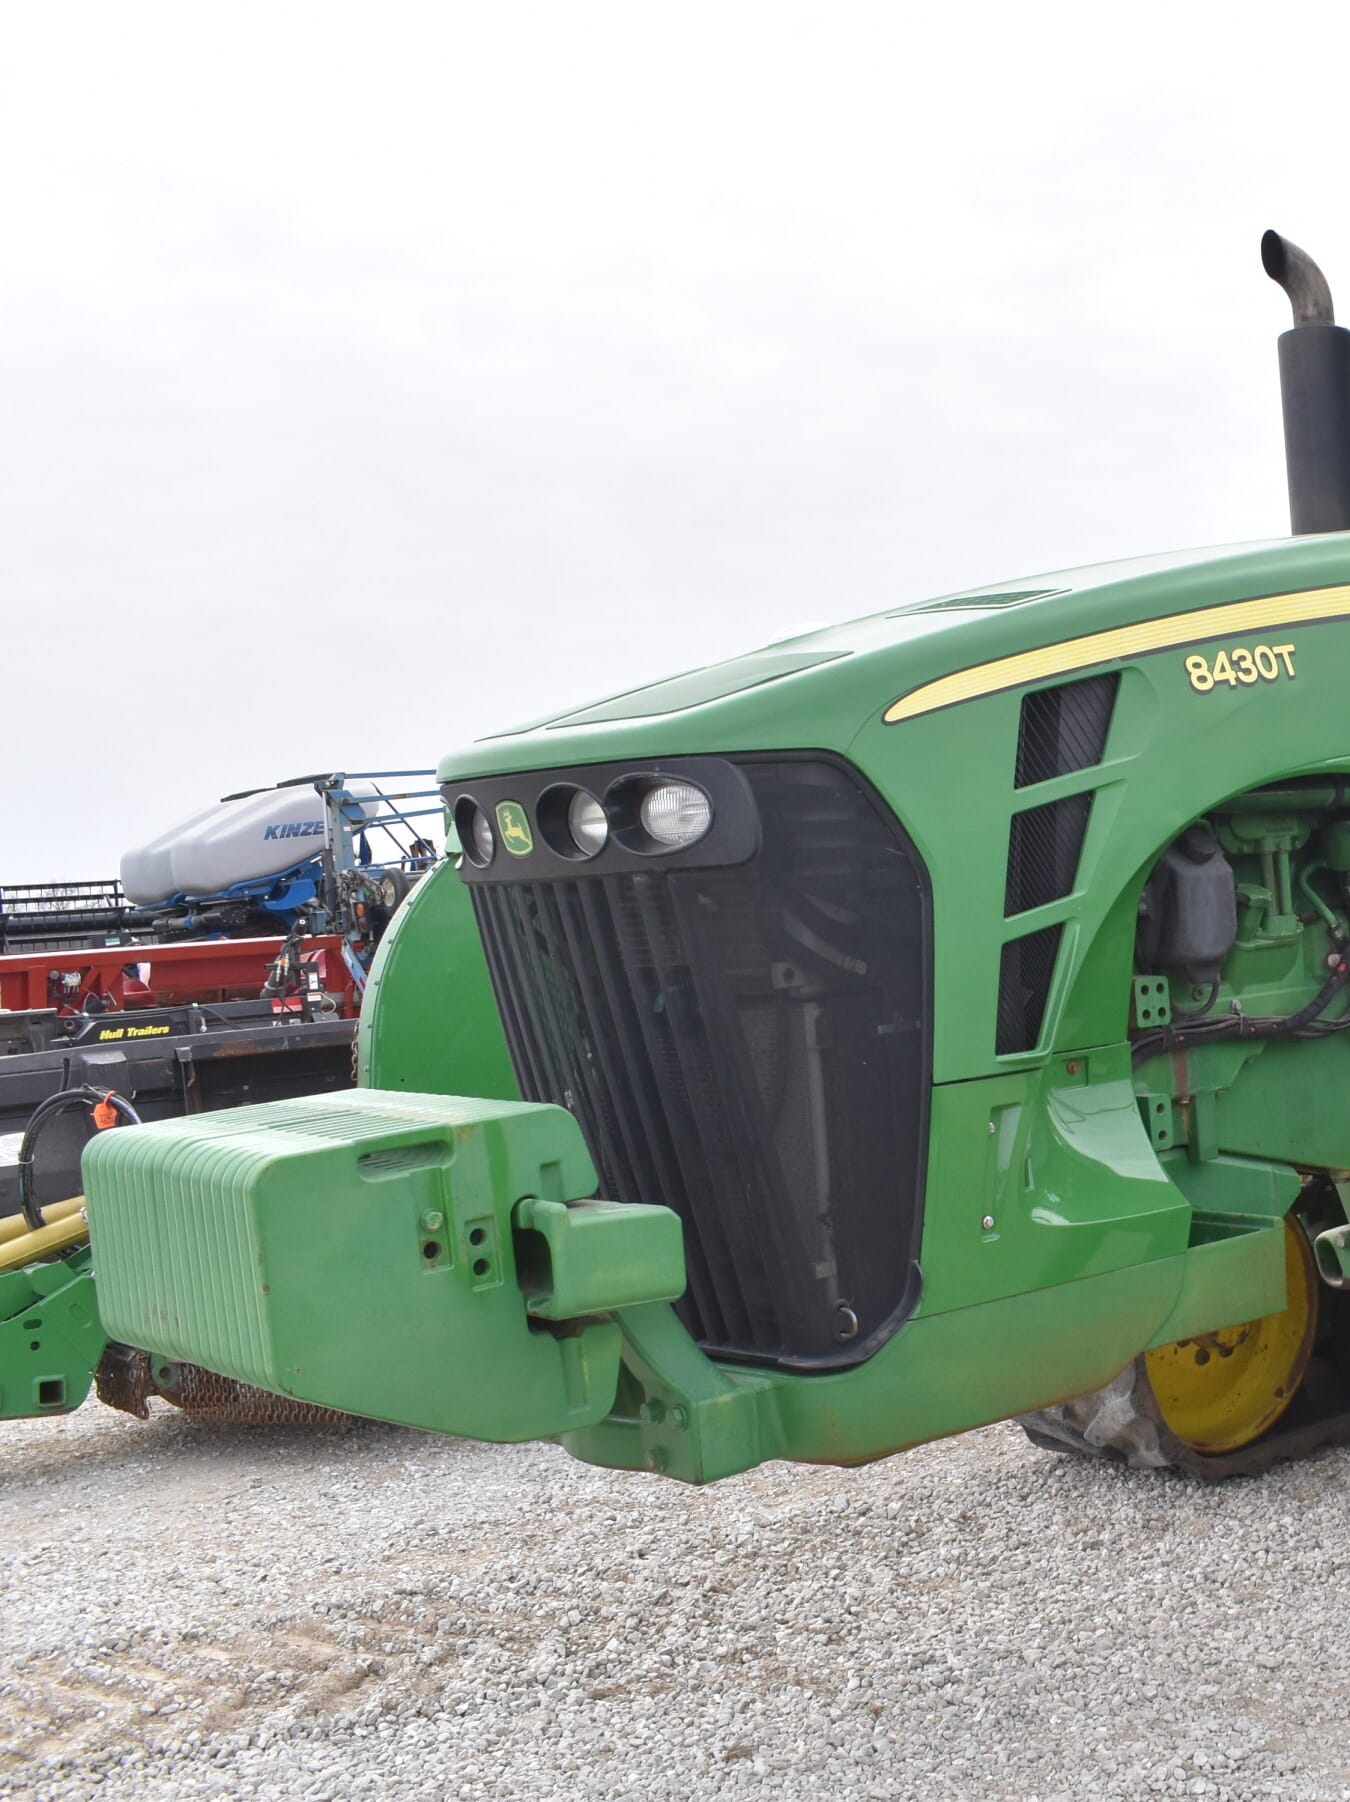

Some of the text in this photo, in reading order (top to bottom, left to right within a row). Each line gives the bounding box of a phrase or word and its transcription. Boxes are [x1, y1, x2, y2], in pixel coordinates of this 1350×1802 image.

[1184, 643, 1296, 691] 8430T
[263, 821, 325, 840] KINZE
[100, 1025, 170, 1040] Hull Trailers
